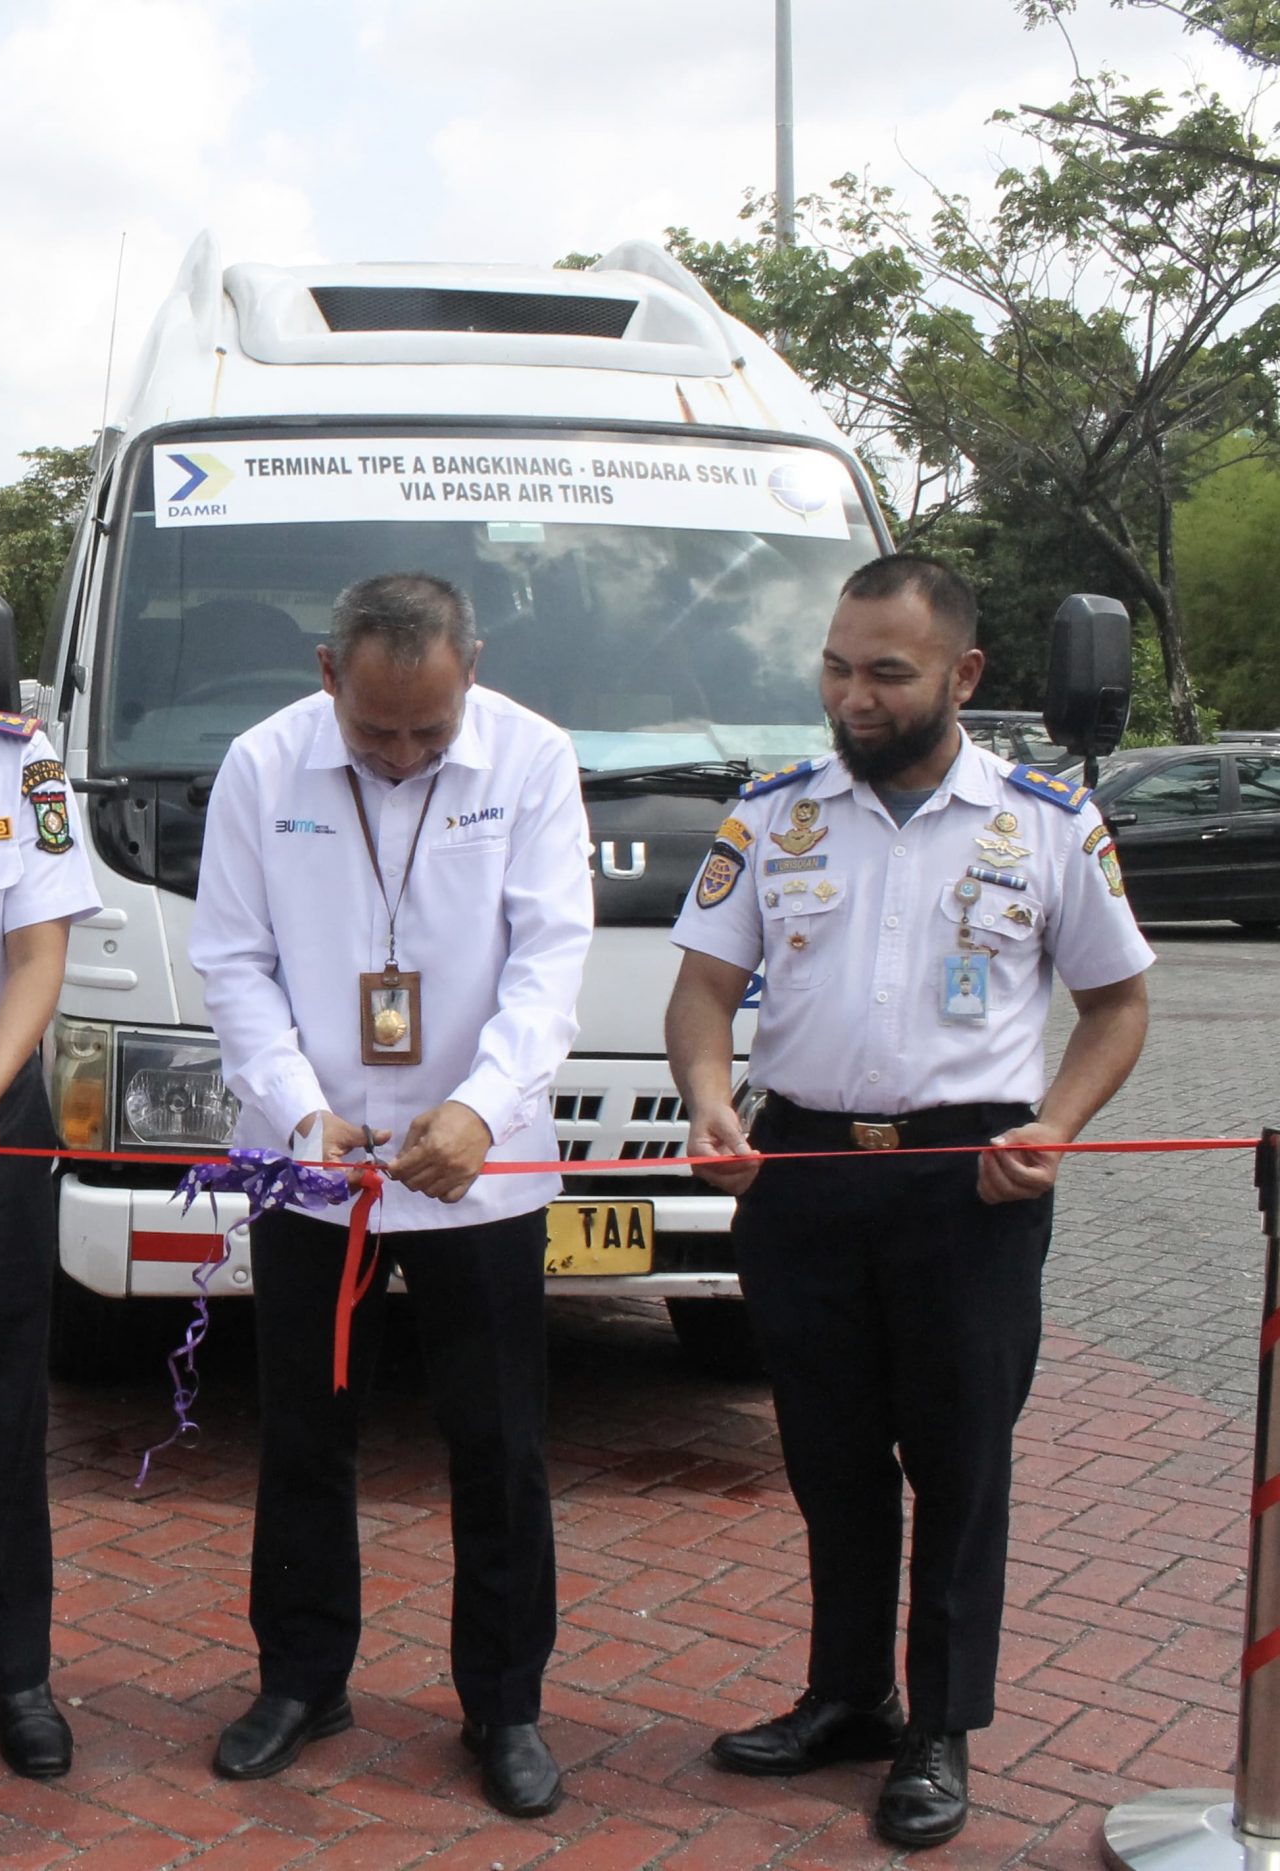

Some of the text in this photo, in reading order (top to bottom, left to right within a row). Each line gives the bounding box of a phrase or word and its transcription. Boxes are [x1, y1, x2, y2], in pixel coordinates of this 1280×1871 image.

[245, 457, 352, 477] TERMINAL
[358, 456, 404, 475] TIPE
[412, 456, 426, 474] A
[433, 456, 572, 477] BANGKINANG
[593, 460, 690, 483] BANDARA
[697, 464, 738, 485] SSK
[743, 468, 757, 486] II
[400, 482, 614, 505] VIA PASAR AIR TIRIS
[168, 504, 227, 518] DAMRI
[459, 807, 504, 827] DAMRI
[578, 1207, 645, 1249] TAA
